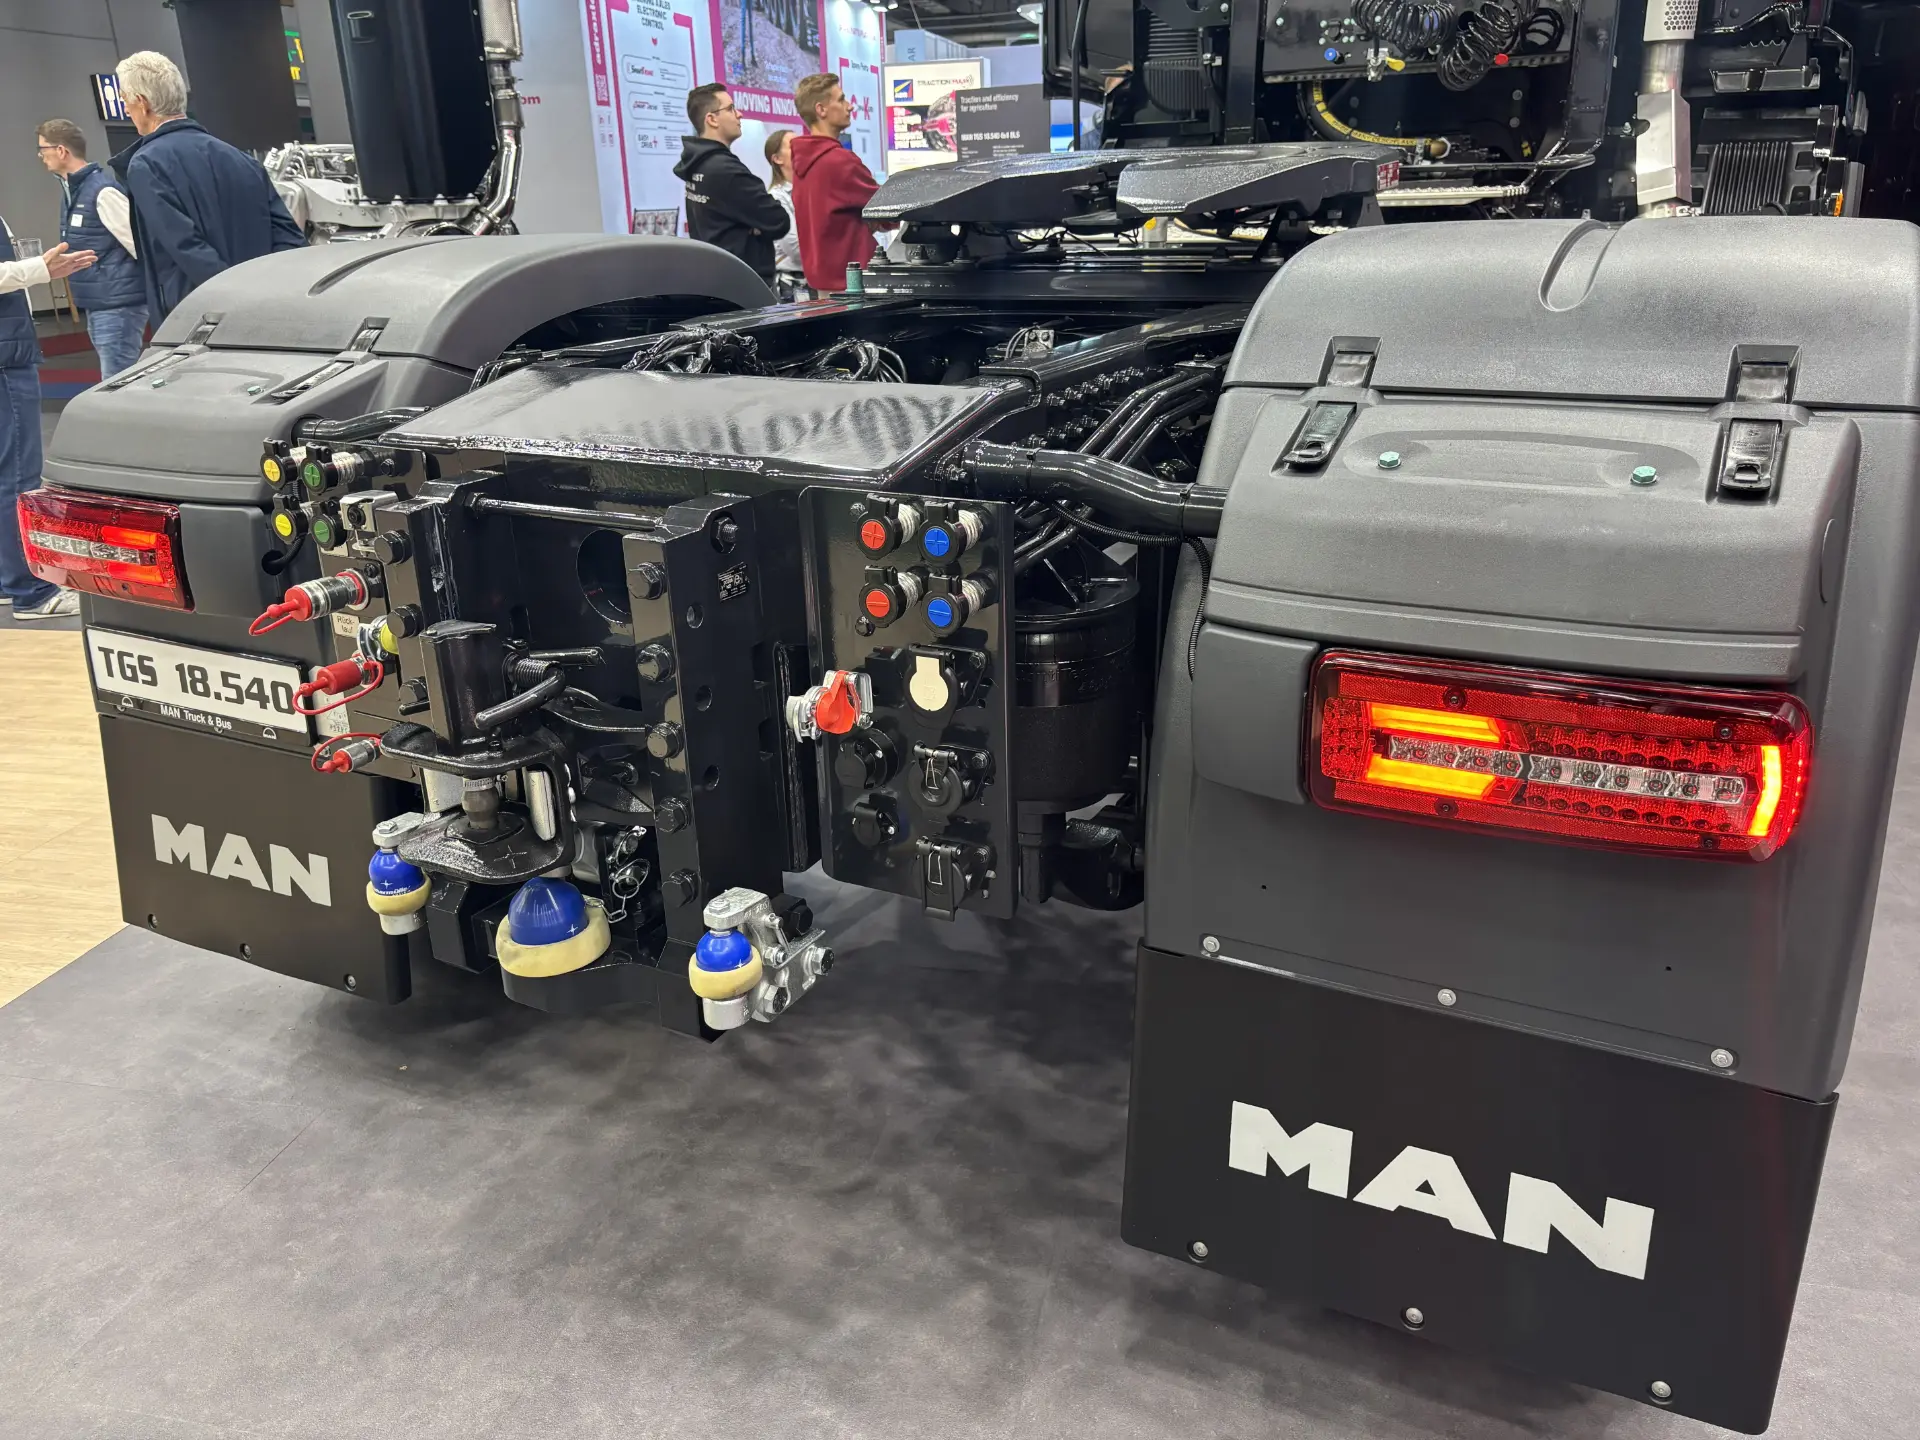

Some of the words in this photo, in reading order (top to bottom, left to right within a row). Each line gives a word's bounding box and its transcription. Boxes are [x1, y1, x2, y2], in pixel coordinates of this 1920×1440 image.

[637, 4, 667, 20] ELECTRONIC
[641, 17, 664, 31] CONTROL
[733, 91, 771, 114] MOVING
[961, 96, 981, 104] Traction
[982, 95, 992, 103] and
[993, 94, 1019, 102] efficiency
[969, 103, 997, 113] agriculture
[337, 615, 355, 625] Rück-
[98, 646, 158, 687] TGS
[175, 662, 295, 716] 18.540
[160, 703, 181, 719] MAN
[183, 709, 207, 724] Truck
[207, 715, 215, 727] &
[215, 716, 233, 730] Bus
[151, 813, 332, 907] MAN
[1228, 1100, 1655, 1281] MAN
